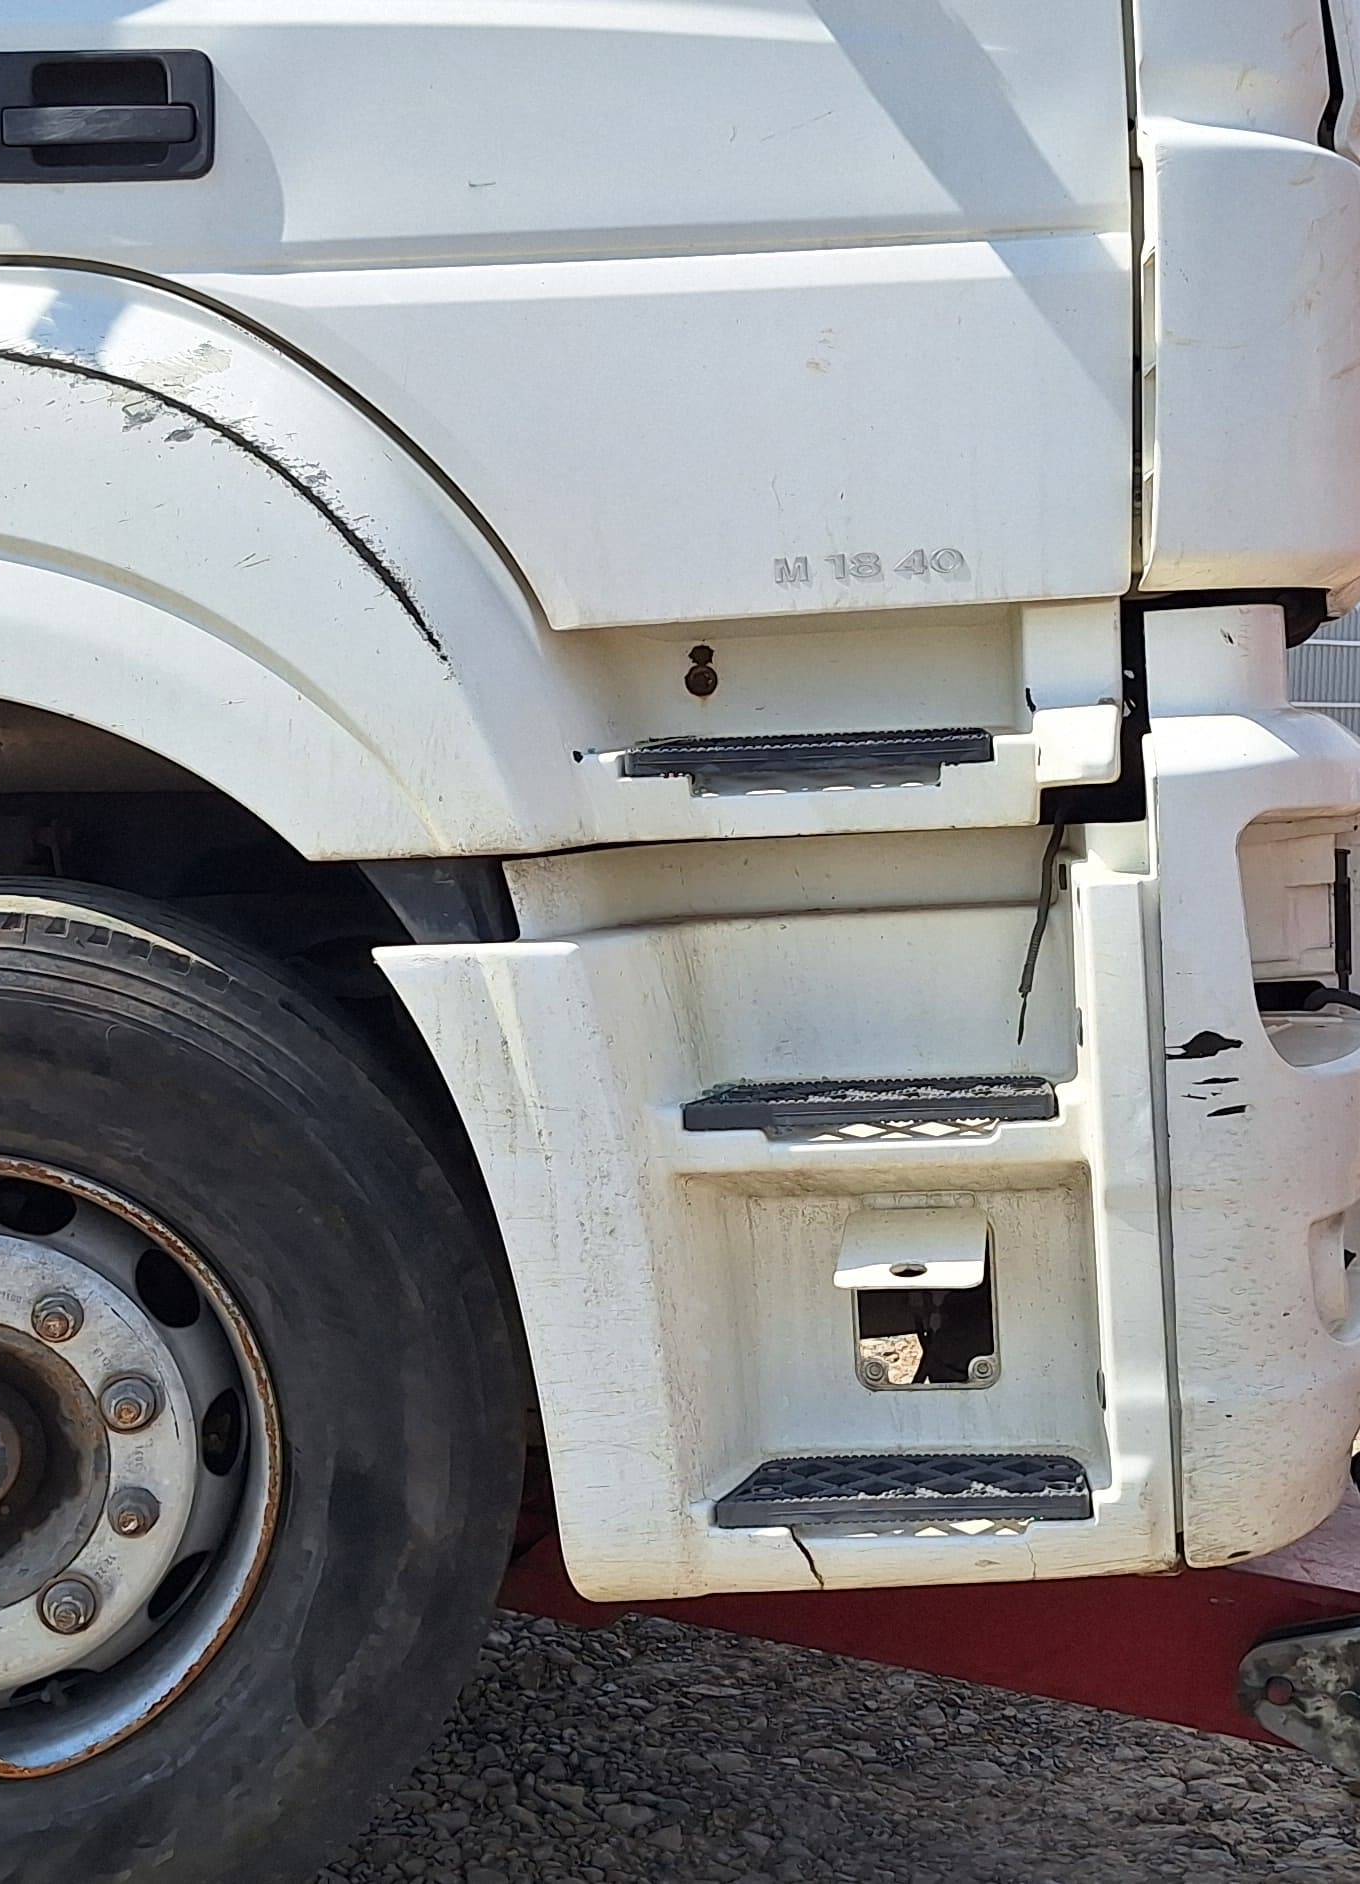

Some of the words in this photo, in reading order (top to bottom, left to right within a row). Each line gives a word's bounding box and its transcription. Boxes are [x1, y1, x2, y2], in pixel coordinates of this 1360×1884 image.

[773, 556, 810, 583] M
[824, 552, 882, 580] 18
[893, 548, 964, 575] 40
